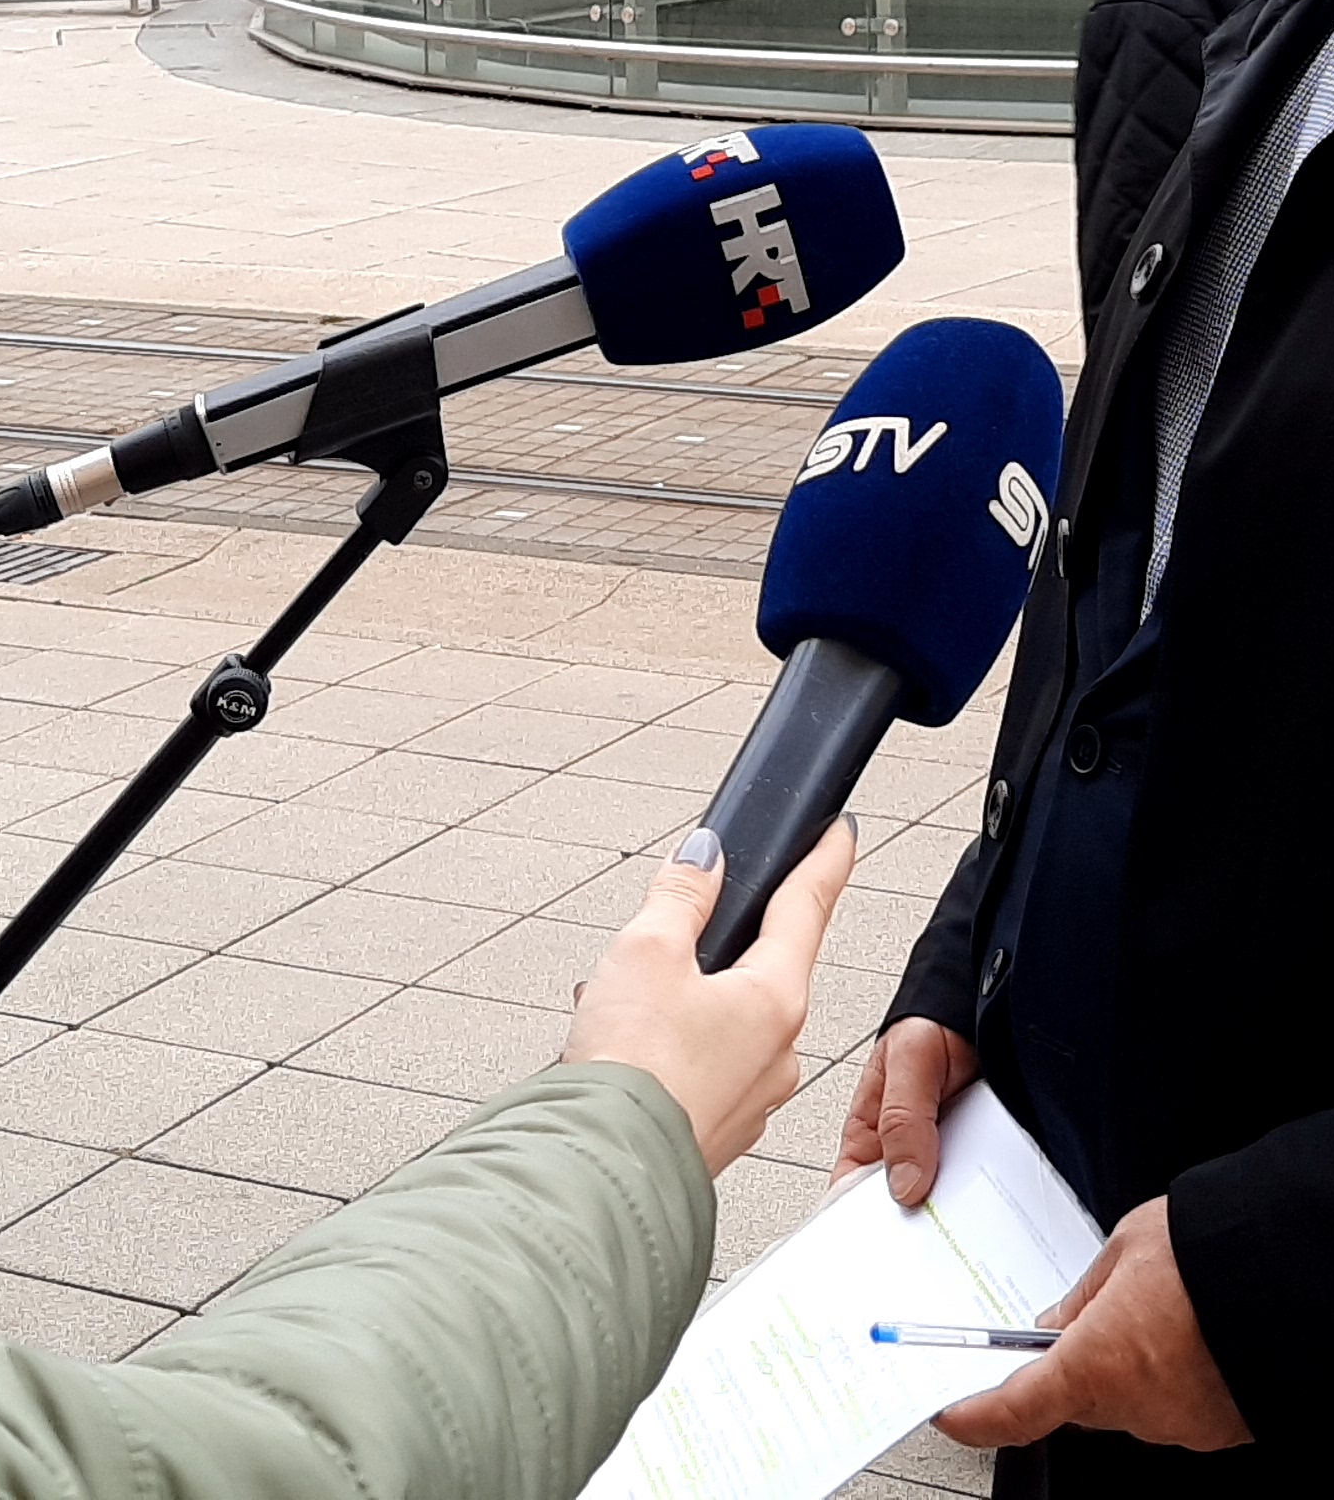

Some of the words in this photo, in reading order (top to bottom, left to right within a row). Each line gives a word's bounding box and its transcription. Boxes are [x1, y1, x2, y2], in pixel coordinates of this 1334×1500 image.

[709, 182, 811, 330] HRT
[795, 416, 948, 485] STV
[216, 696, 257, 717] K&M
